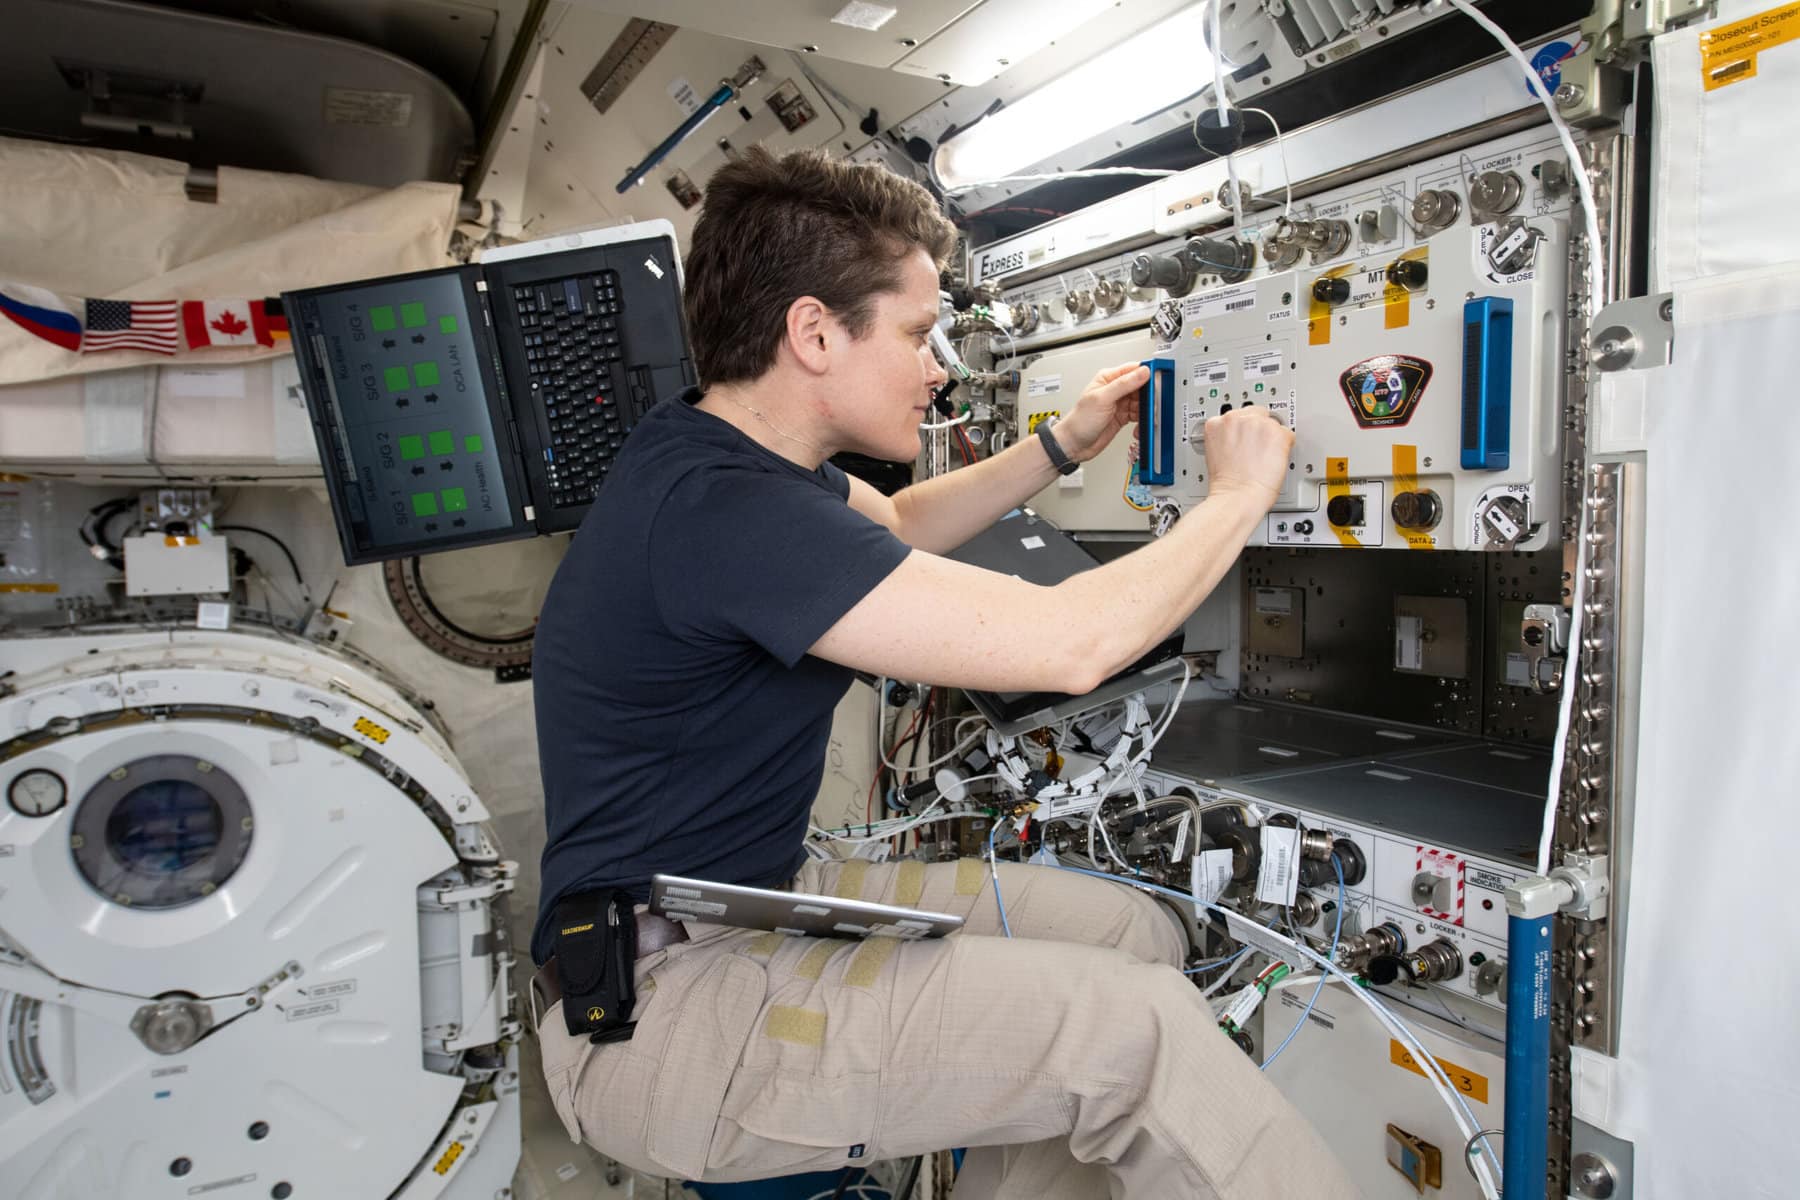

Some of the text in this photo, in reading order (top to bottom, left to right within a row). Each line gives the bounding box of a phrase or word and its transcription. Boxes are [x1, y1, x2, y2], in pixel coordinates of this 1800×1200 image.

[1708, 21, 1758, 45] Closeout
[1482, 155, 1512, 170] LOCKER
[1319, 206, 1342, 217] LOCKER
[1506, 271, 1534, 284] CLOSE
[1352, 292, 1376, 302] SUPPLY
[346, 303, 366, 342] S/G 4
[1269, 310, 1291, 320] STATUS
[361, 362, 379, 401] S/G 3
[375, 432, 395, 469] S/G 2
[474, 461, 488, 493] Health
[1507, 484, 1529, 492] OPEN
[391, 489, 409, 526] S/G 1
[1477, 871, 1502, 883] SMOKE
[1430, 921, 1457, 935] LOCKER
[1460, 1075, 1473, 1092] 3
